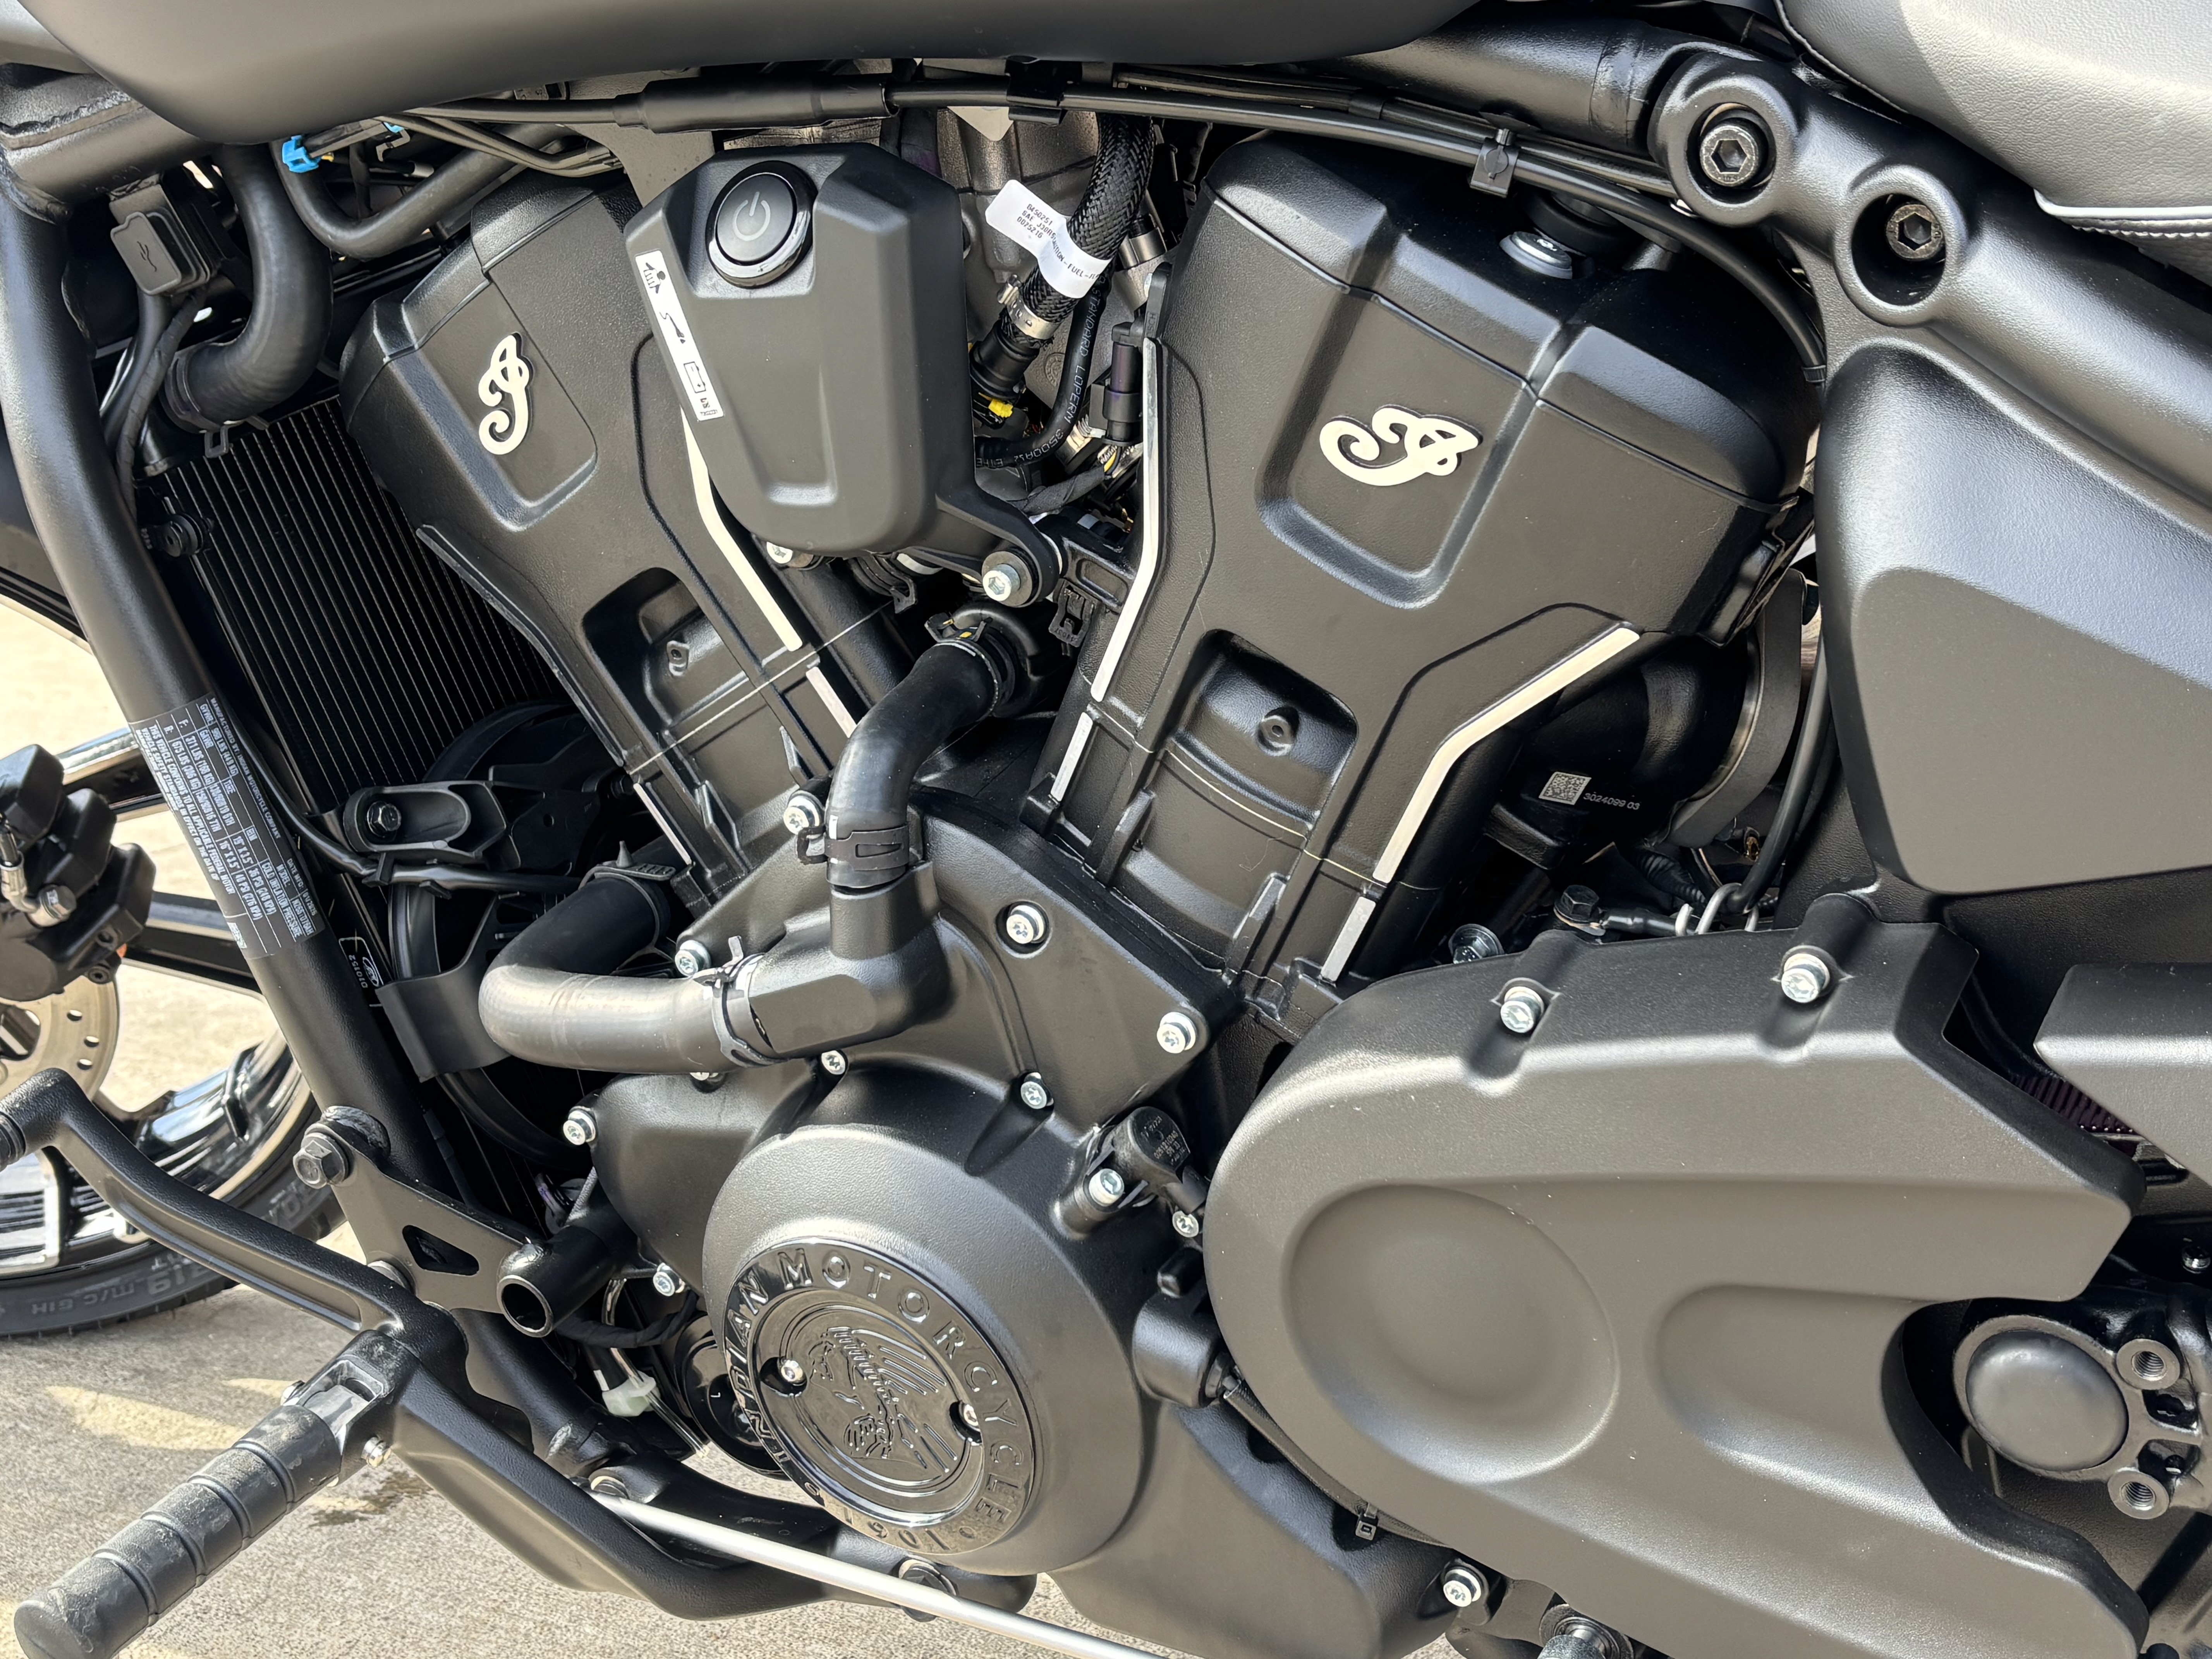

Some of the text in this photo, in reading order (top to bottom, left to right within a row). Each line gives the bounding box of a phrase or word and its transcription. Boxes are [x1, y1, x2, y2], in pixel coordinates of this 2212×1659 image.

[1080, 287, 1101, 357] STANDARD
[148, 724, 162, 740] THIS
[155, 738, 173, 764] VEHICLE
[166, 762, 189, 796] CONFORMS
[182, 795, 192, 805] TO
[185, 802, 197, 816] ALL
[1583, 792, 1641, 810] 3024099 03
[191, 814, 214, 850] APPLICABLE
[348, 955, 368, 988] 010152
[776, 1248, 1025, 1526] MOTORCYCLE
